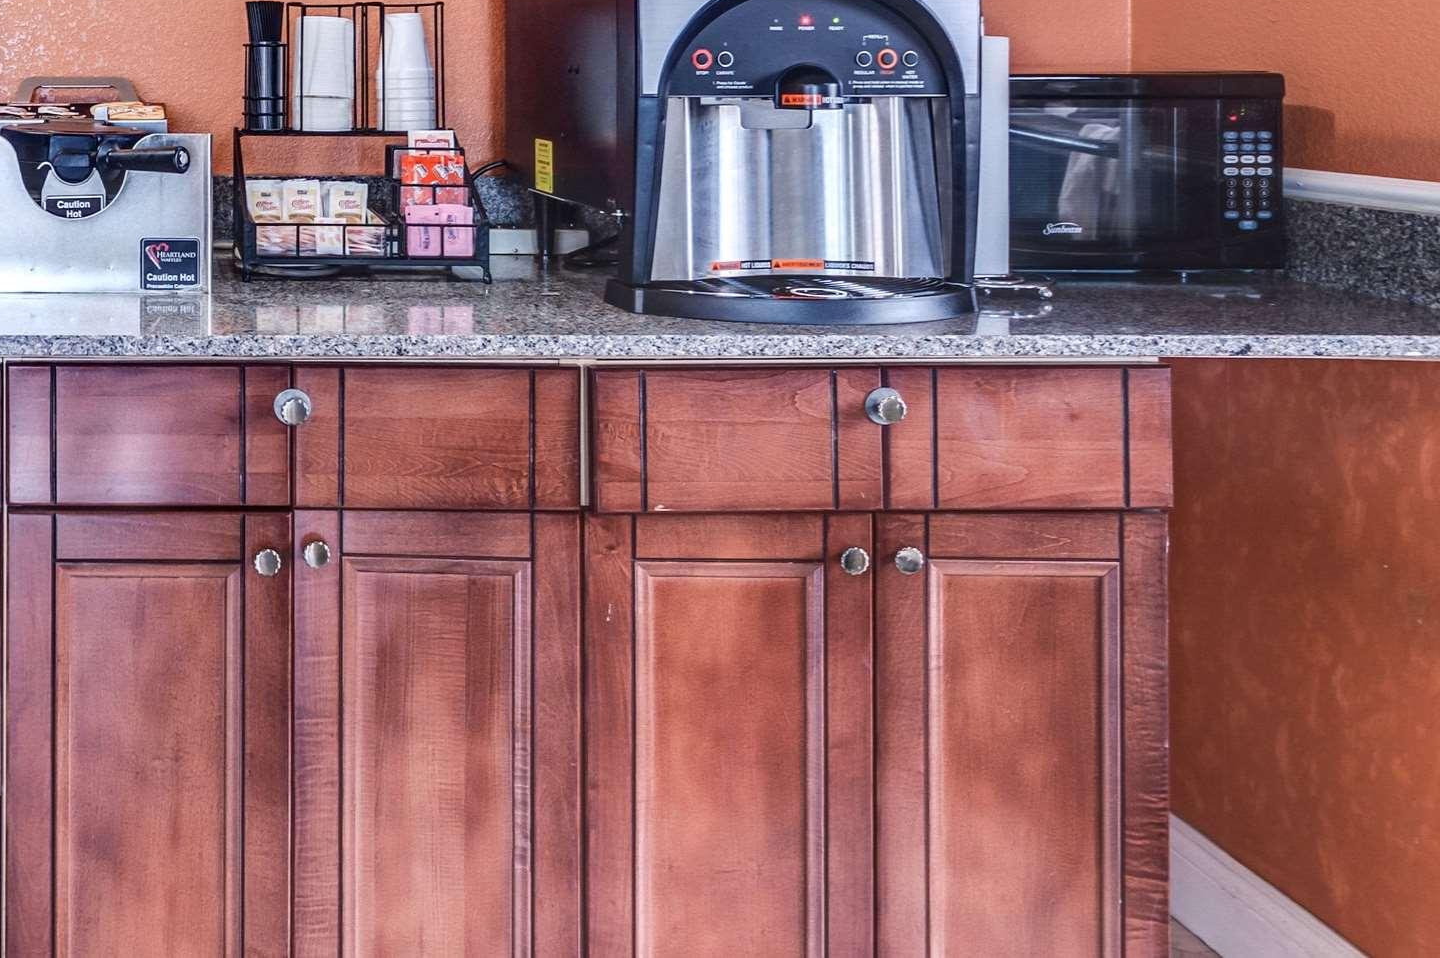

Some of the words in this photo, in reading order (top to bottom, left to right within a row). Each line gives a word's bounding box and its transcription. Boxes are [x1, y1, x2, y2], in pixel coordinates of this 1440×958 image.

[56, 200, 91, 209] Caution
[66, 210, 82, 218] Hot
[156, 251, 196, 259] HEARTLAND
[146, 273, 178, 281] Caution
[180, 273, 195, 281] Hot
